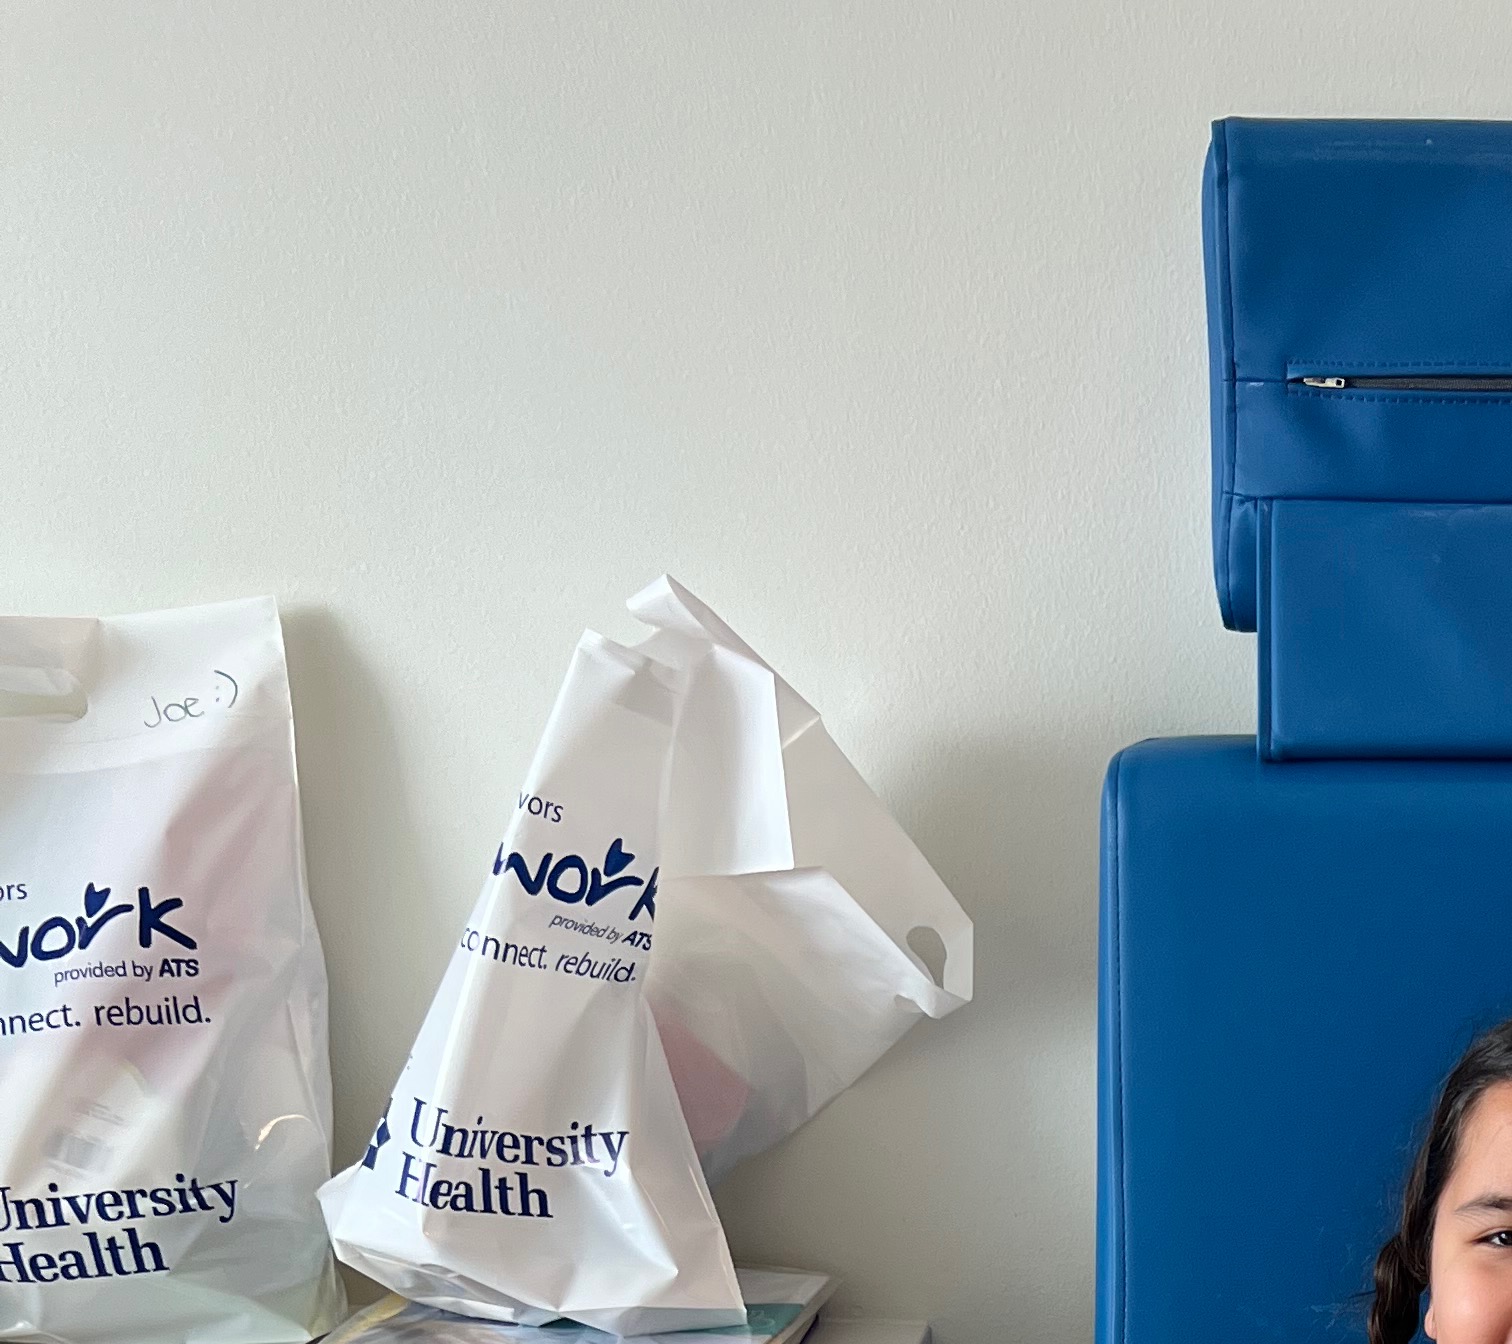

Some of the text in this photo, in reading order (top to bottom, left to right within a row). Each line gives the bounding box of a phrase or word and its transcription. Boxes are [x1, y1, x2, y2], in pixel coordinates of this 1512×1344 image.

[143, 695, 205, 728] Joe
[548, 913, 653, 951] provided by ATS
[54, 957, 200, 987] provided by ATS
[555, 951, 636, 983] rebuild.
[93, 994, 212, 1027] rebuild.
[410, 1096, 630, 1178] University
[395, 1150, 554, 1219] Health
